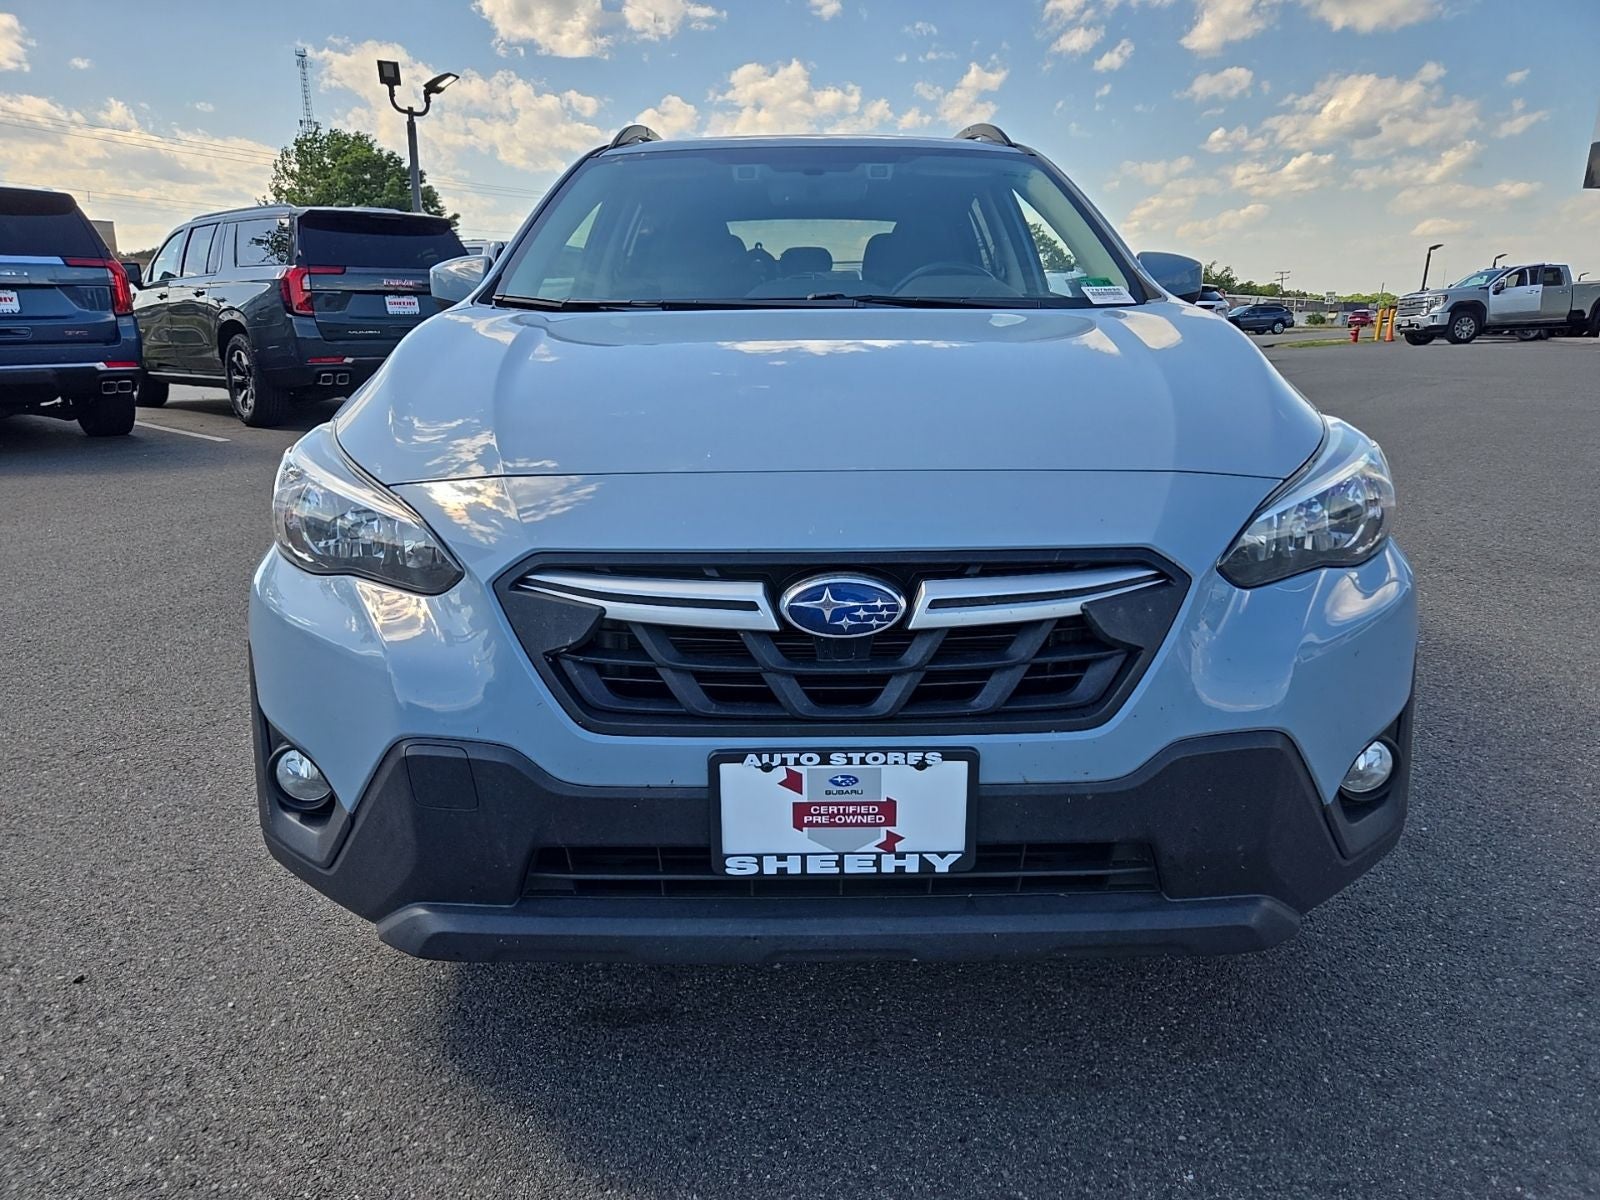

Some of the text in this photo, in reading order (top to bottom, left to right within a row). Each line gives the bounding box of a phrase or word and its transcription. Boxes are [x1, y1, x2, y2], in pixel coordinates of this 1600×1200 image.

[743, 752, 943, 767] AUTO STORES
[810, 805, 879, 815] CERTIFIED
[803, 815, 886, 825] PRE-OWNED
[725, 854, 962, 875] SHEEHY
